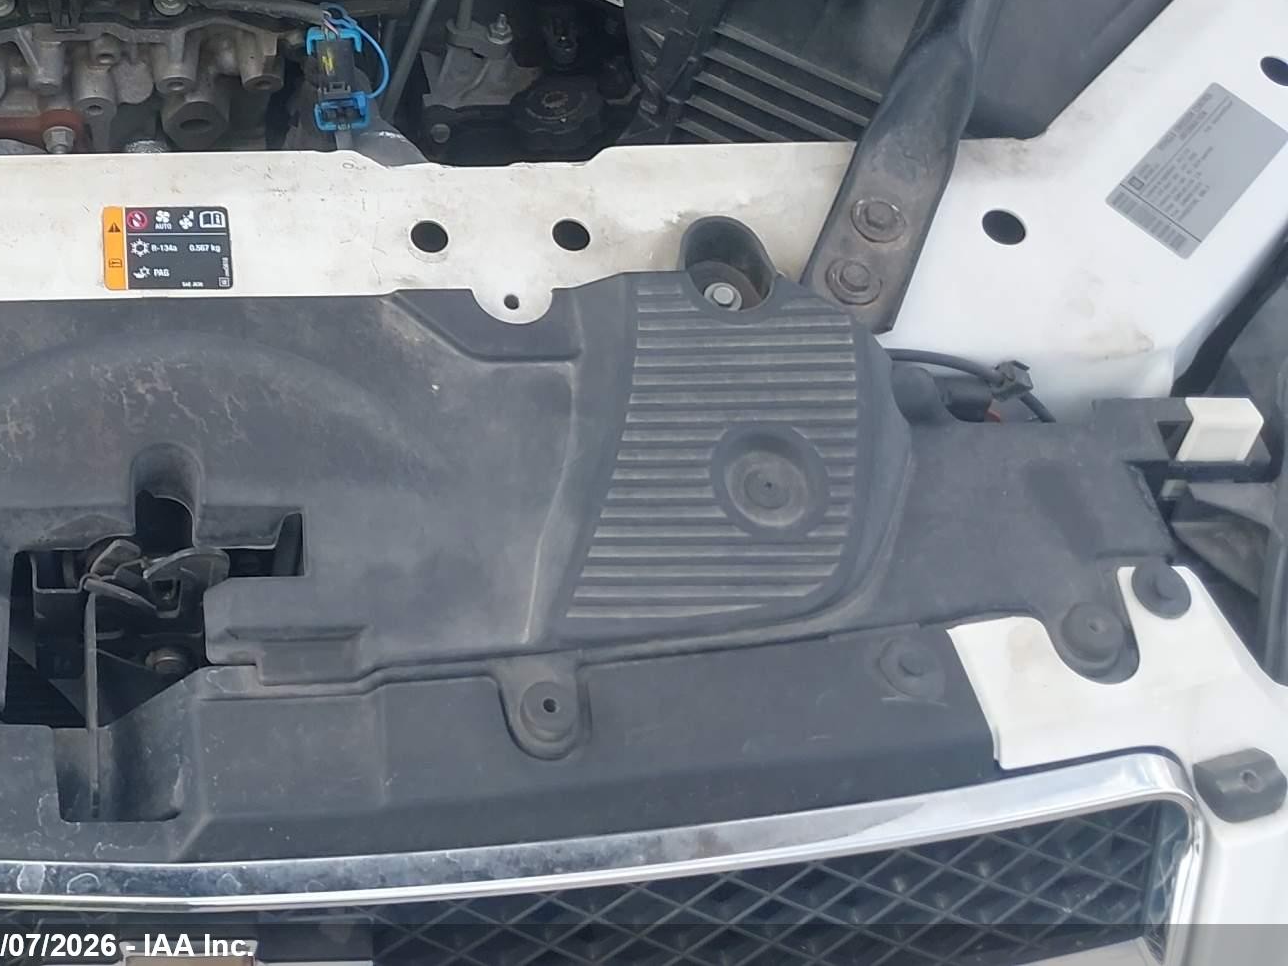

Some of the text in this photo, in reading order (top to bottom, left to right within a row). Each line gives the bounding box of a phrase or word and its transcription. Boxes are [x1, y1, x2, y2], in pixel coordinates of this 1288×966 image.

[154, 222, 173, 230] AUTO
[150, 244, 178, 252] R-134a
[210, 243, 222, 253] kg
